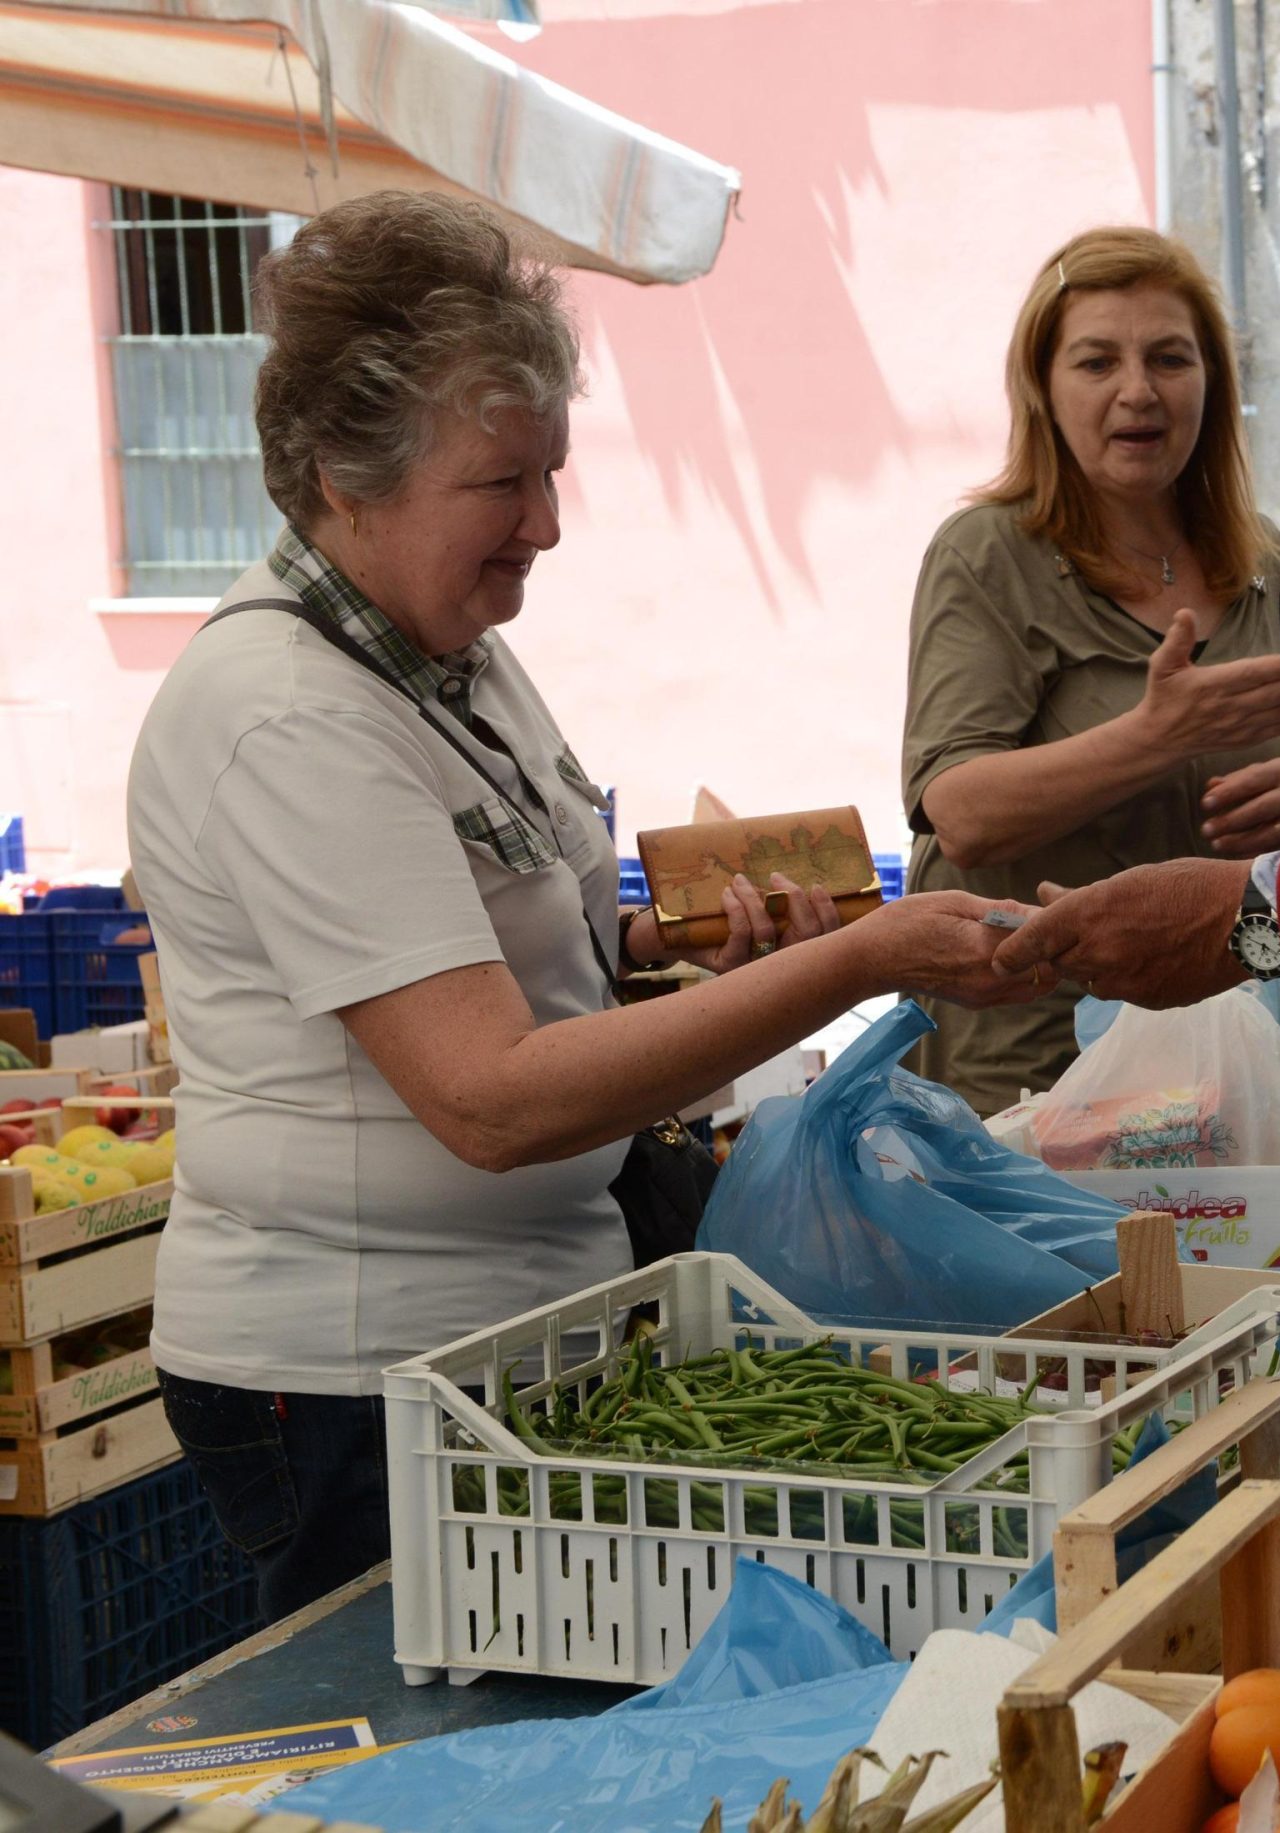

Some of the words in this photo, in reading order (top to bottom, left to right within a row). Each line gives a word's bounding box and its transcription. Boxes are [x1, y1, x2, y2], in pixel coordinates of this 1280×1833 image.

[206, 1741, 275, 1755] PREVENTIVI
[242, 1742, 335, 1760] RITIRIAMO
[143, 1752, 202, 1761] GRATUITI
[162, 1751, 244, 1765] DIAMANTI
[174, 1757, 236, 1769] ANCHE
[86, 1765, 166, 1777] ARGENTO
